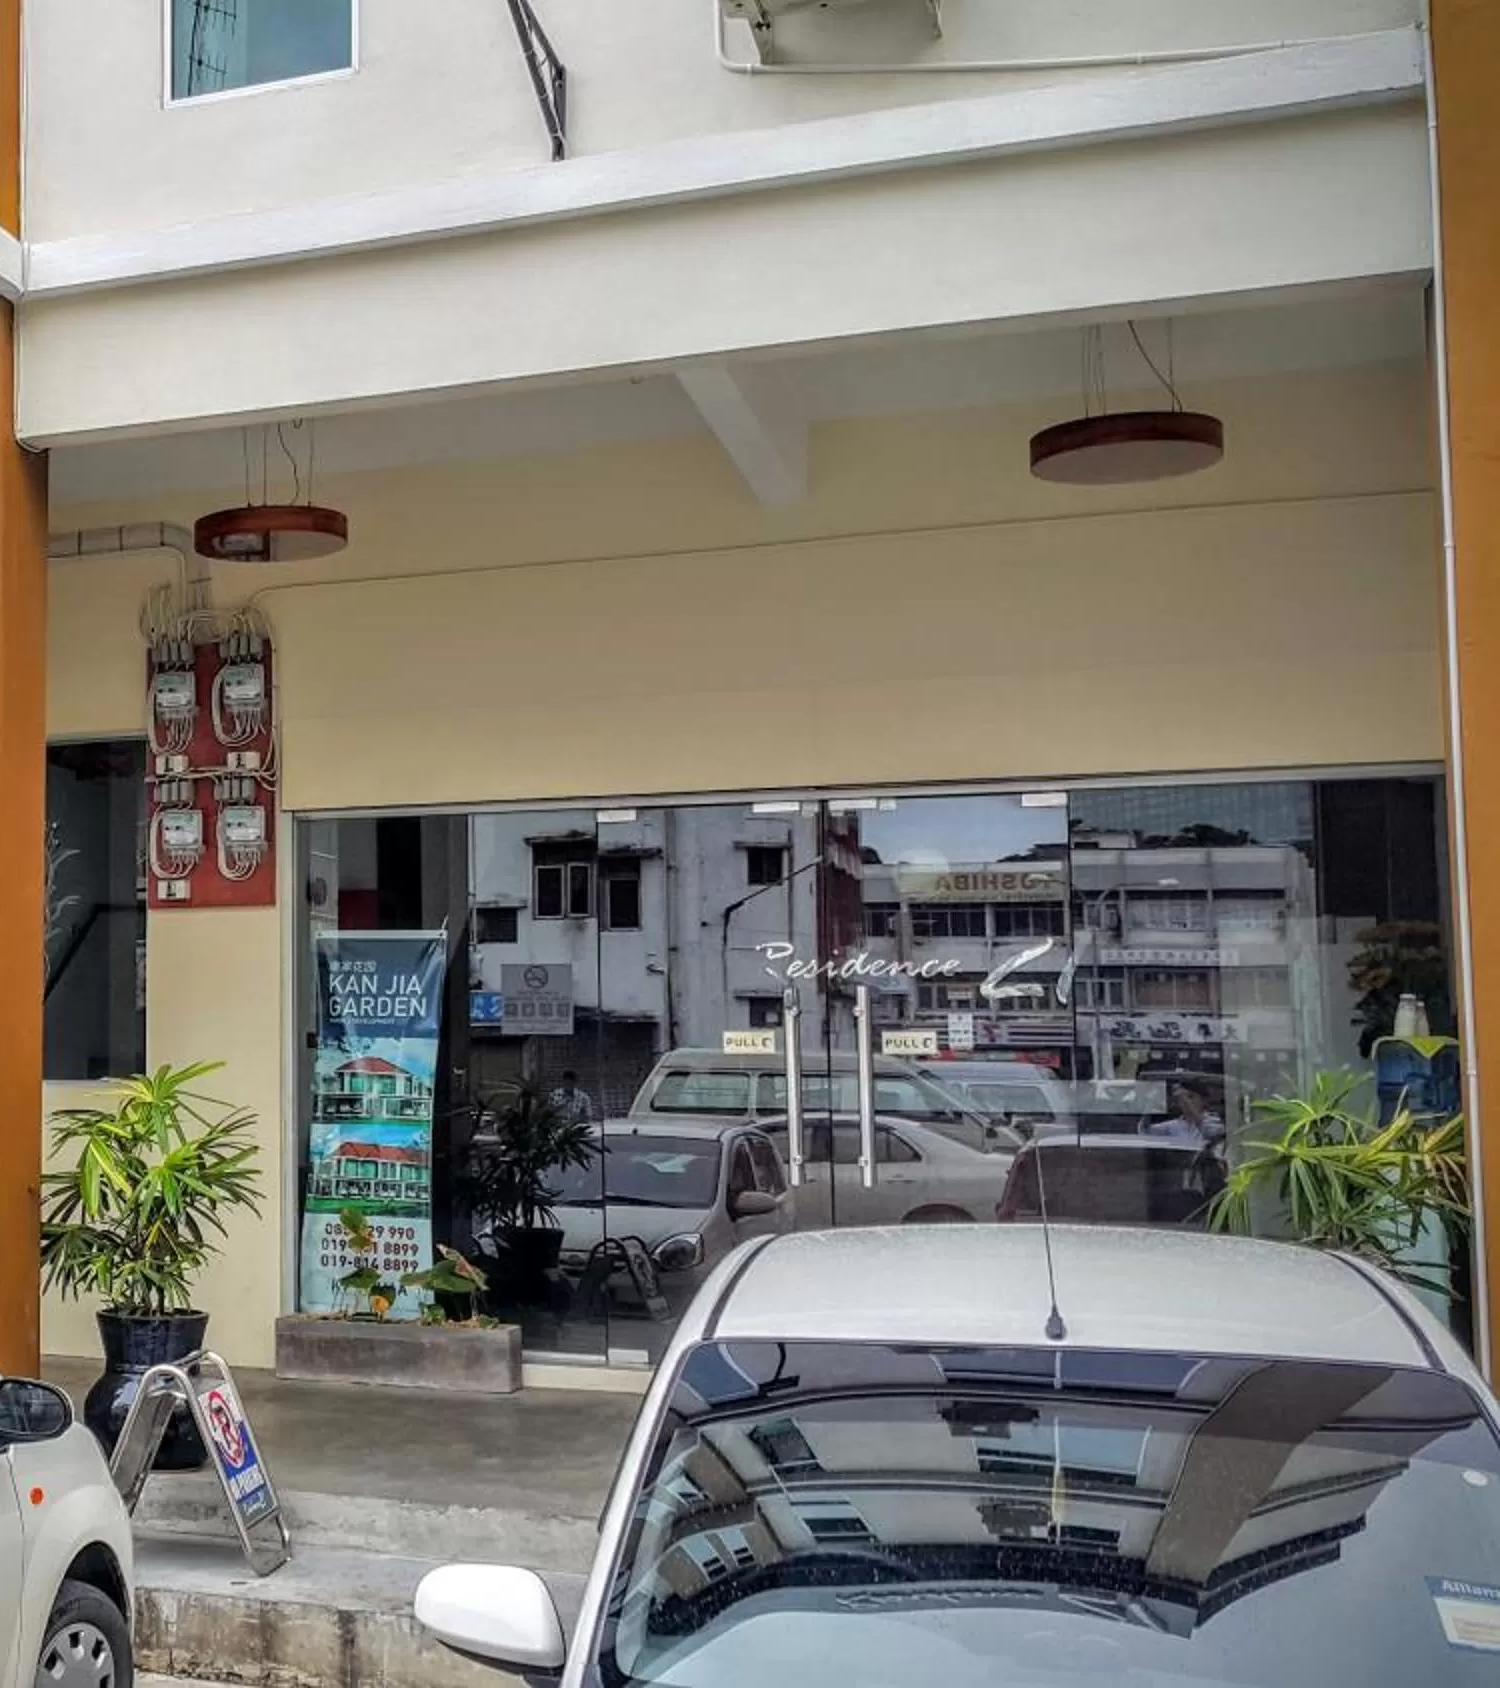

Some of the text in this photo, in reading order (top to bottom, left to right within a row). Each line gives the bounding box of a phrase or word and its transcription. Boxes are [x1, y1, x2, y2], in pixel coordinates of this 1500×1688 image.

[755, 941, 961, 980] Residence
[329, 974, 422, 995] KAN JIA
[329, 996, 427, 1017] GARDEN
[885, 1038, 919, 1049] PULL
